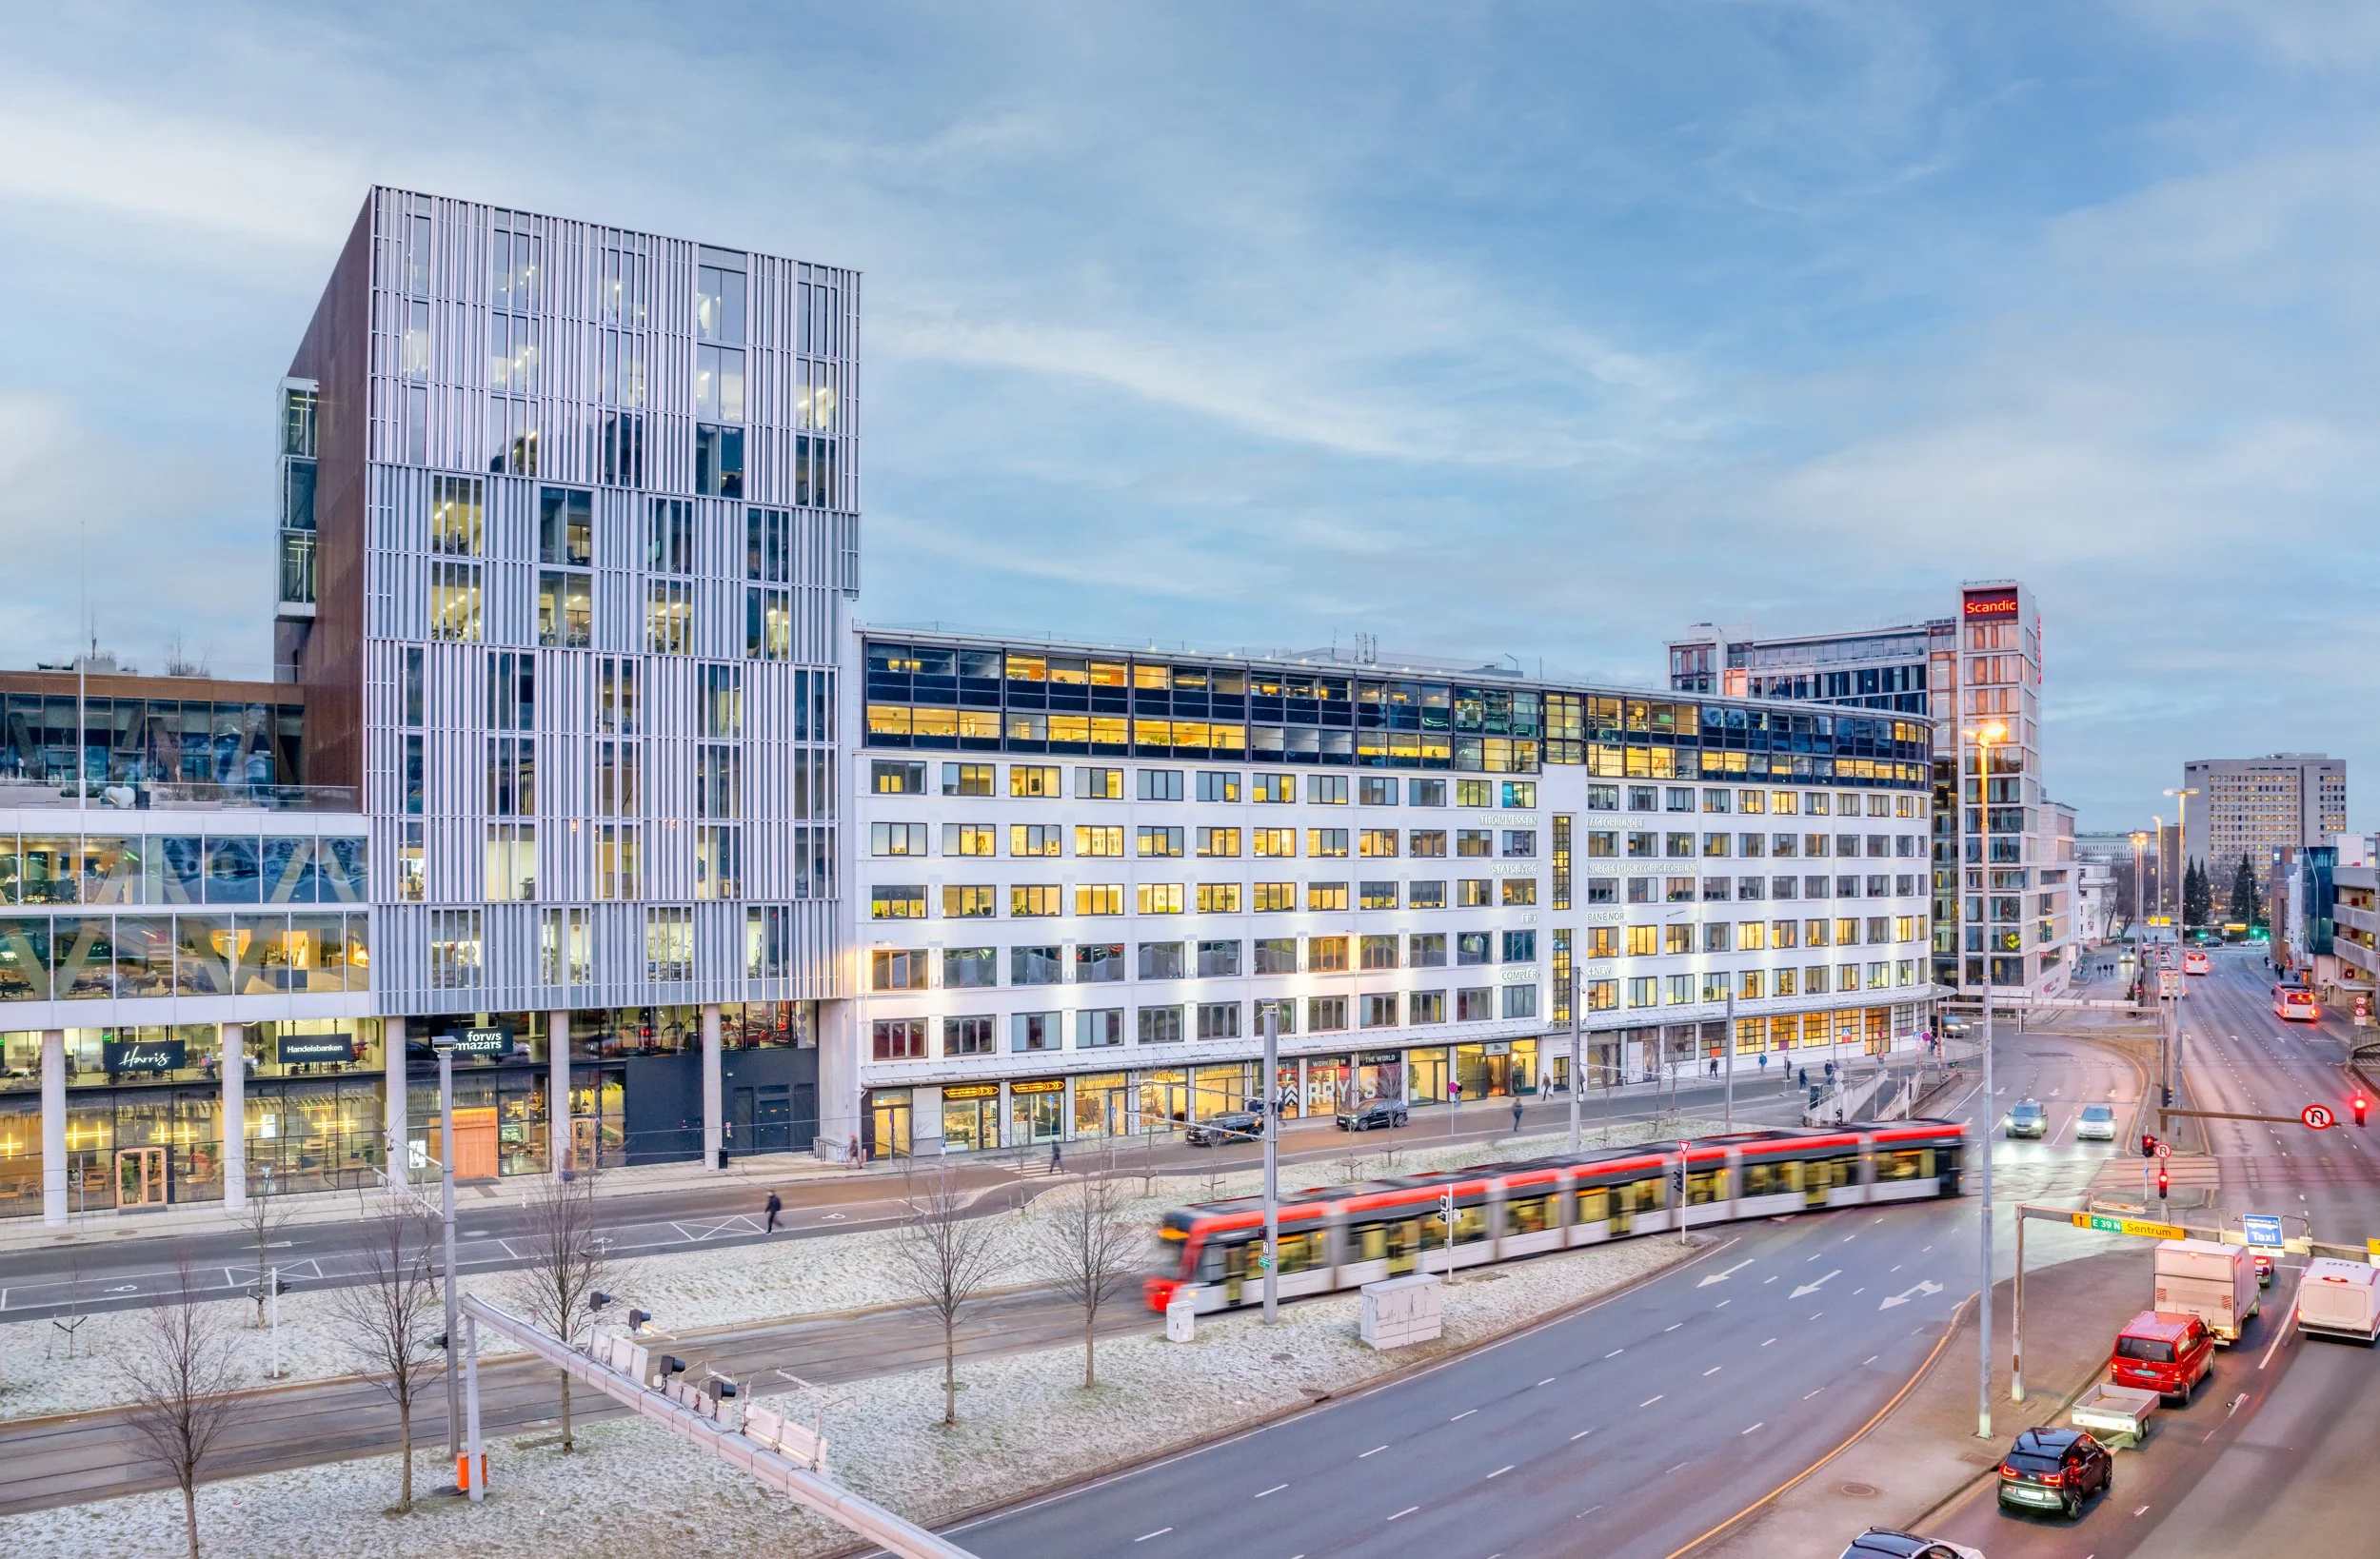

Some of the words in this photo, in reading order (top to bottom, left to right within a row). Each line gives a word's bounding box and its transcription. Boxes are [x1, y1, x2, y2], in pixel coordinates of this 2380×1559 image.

[1966, 600, 2016, 614] Scandic
[1480, 814, 1538, 826] THOMMESSEN
[1492, 863, 1538, 875] STATSBYGG
[1587, 863, 1616, 874] NORGES
[1587, 913, 1608, 921] BANE
[1609, 912, 1624, 921] NOR
[466, 1031, 502, 1041] forvis
[457, 1041, 502, 1050] mazars
[119, 1046, 171, 1067] Harris
[2092, 1218, 2099, 1227] E
[2100, 1220, 2112, 1229] 39
[2113, 1221, 2121, 1230] N
[2127, 1223, 2172, 1236] Sentrum
[2251, 1231, 2276, 1242] Taxi
